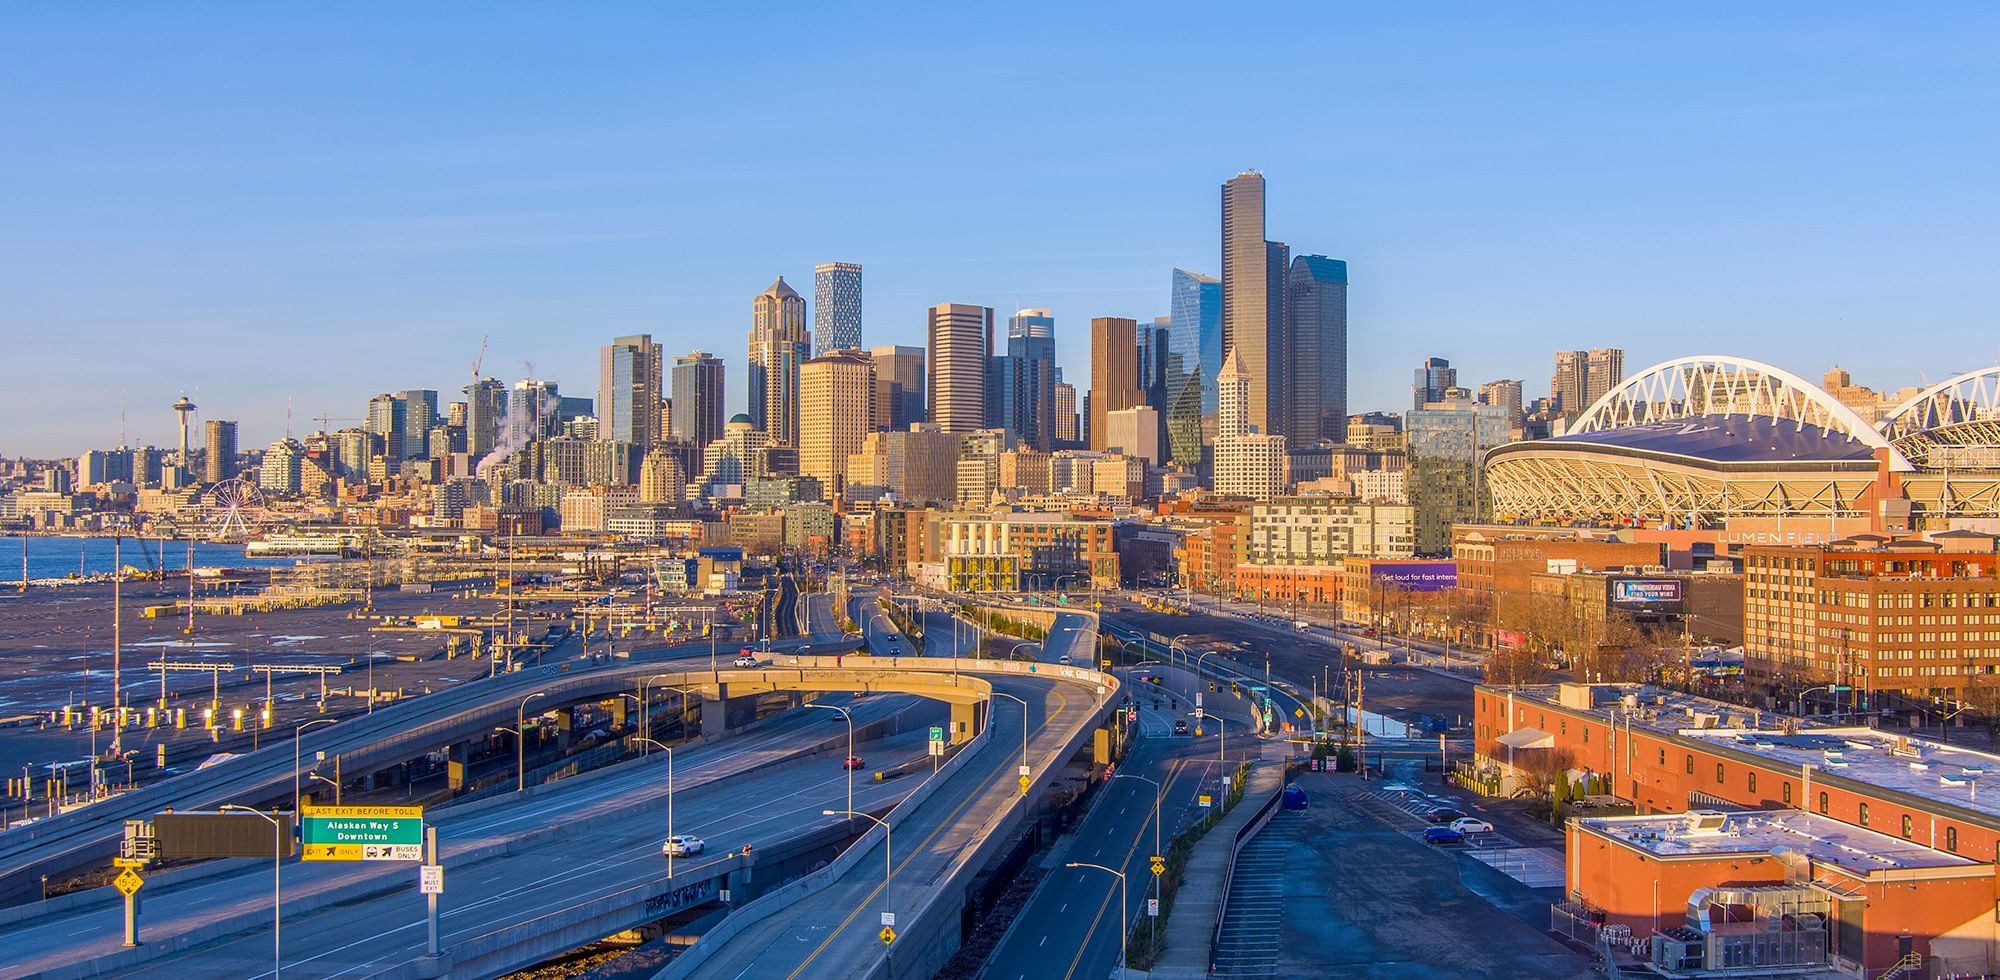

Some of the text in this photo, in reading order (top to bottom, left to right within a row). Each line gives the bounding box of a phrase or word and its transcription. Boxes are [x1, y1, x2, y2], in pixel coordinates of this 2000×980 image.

[1718, 532, 1782, 543] LUMEN
[1381, 573, 1394, 581] Get
[1395, 573, 1410, 581] loud
[1411, 573, 1421, 581] for
[1422, 573, 1435, 581] fast
[370, 822, 389, 831] Way
